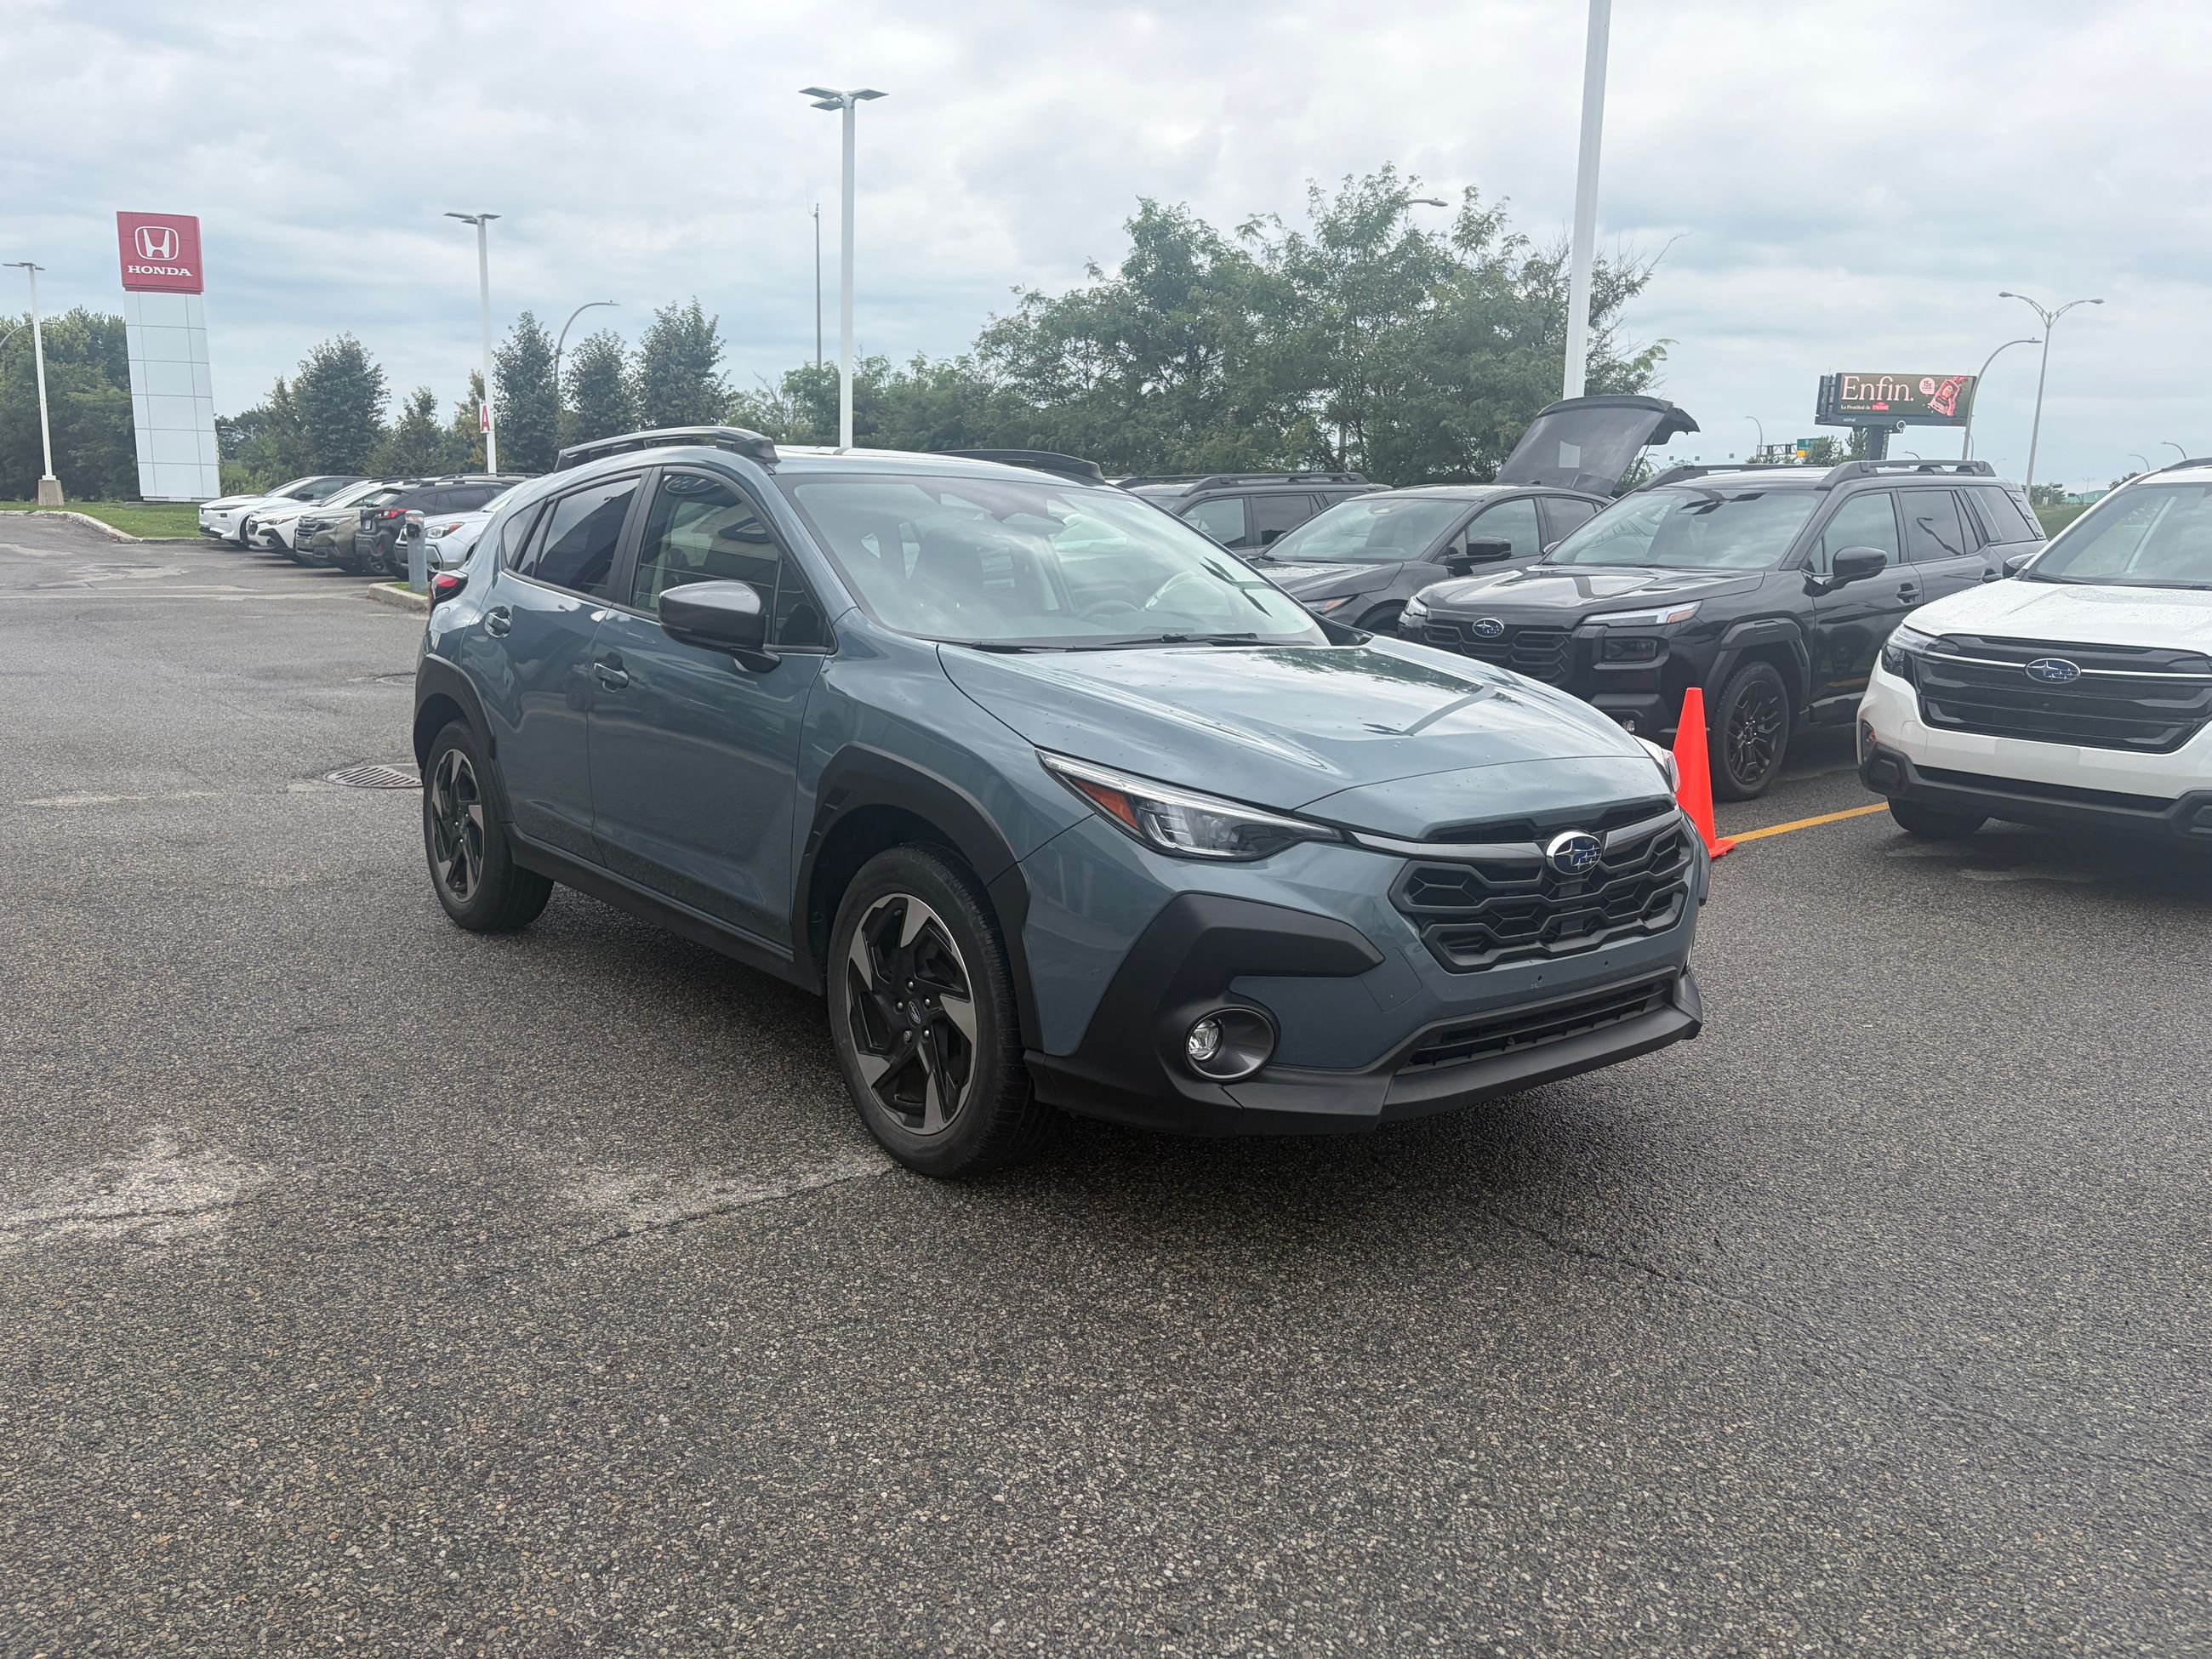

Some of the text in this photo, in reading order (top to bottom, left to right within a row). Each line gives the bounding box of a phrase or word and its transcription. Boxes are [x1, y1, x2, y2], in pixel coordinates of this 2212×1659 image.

[128, 265, 192, 276] HONDA
[1842, 376, 1914, 402] Enfin.
[481, 405, 490, 431] A
